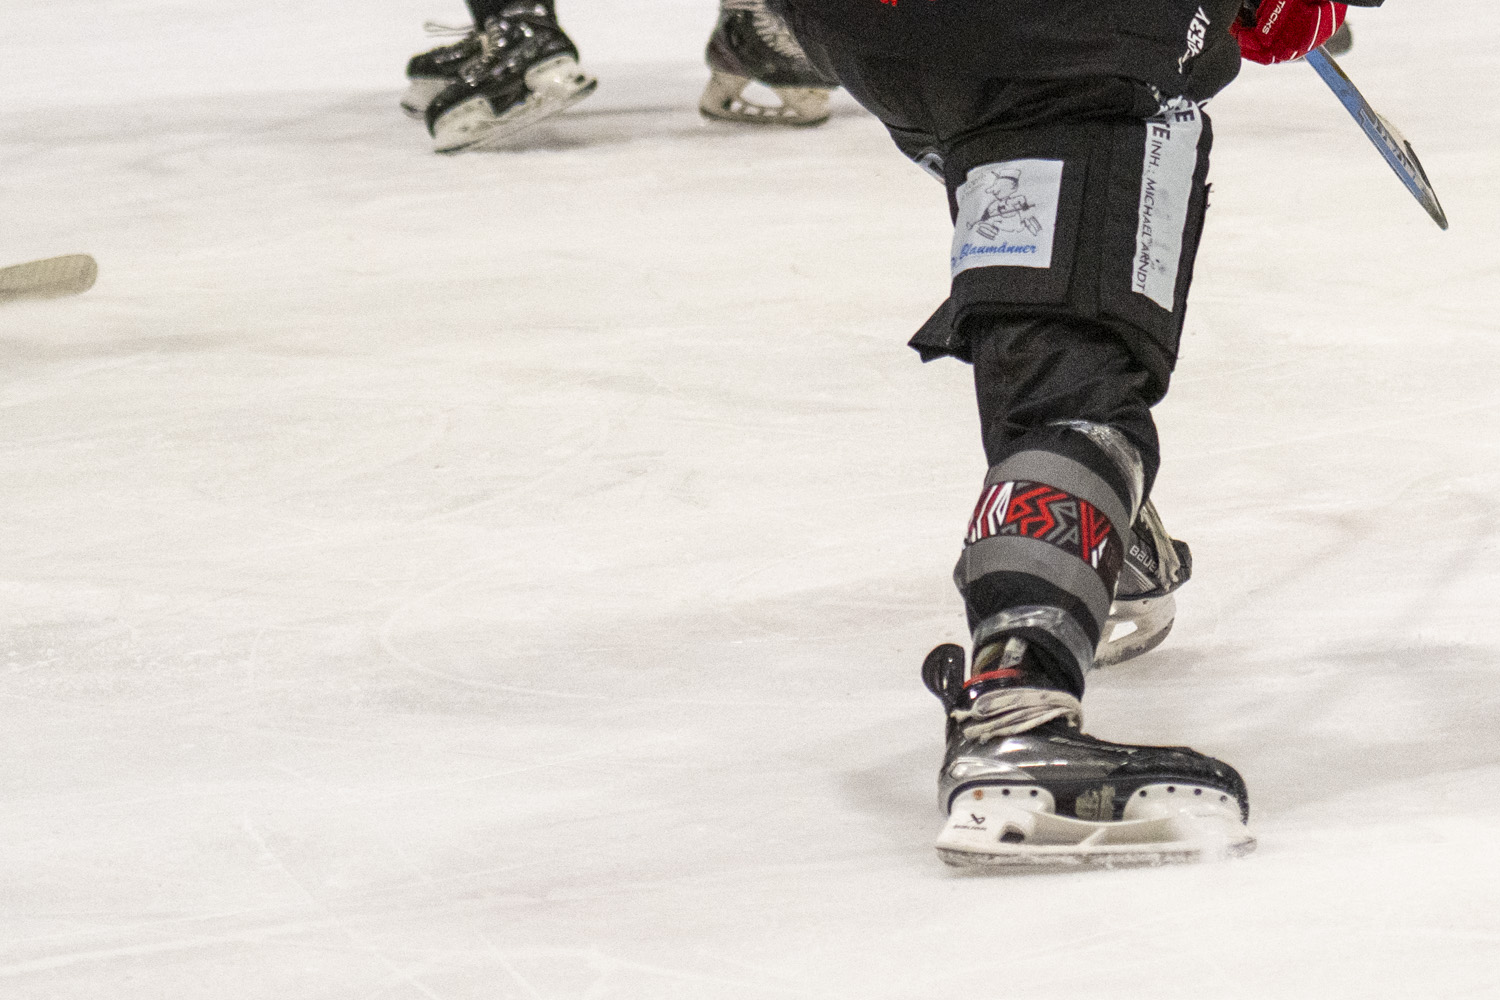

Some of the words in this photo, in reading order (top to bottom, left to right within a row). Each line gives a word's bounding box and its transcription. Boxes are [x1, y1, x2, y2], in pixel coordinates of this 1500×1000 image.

[1261, 0, 1286, 35] TACKS
[1141, 177, 1157, 239] MICHAEL
[1136, 243, 1150, 292] ARNDT
